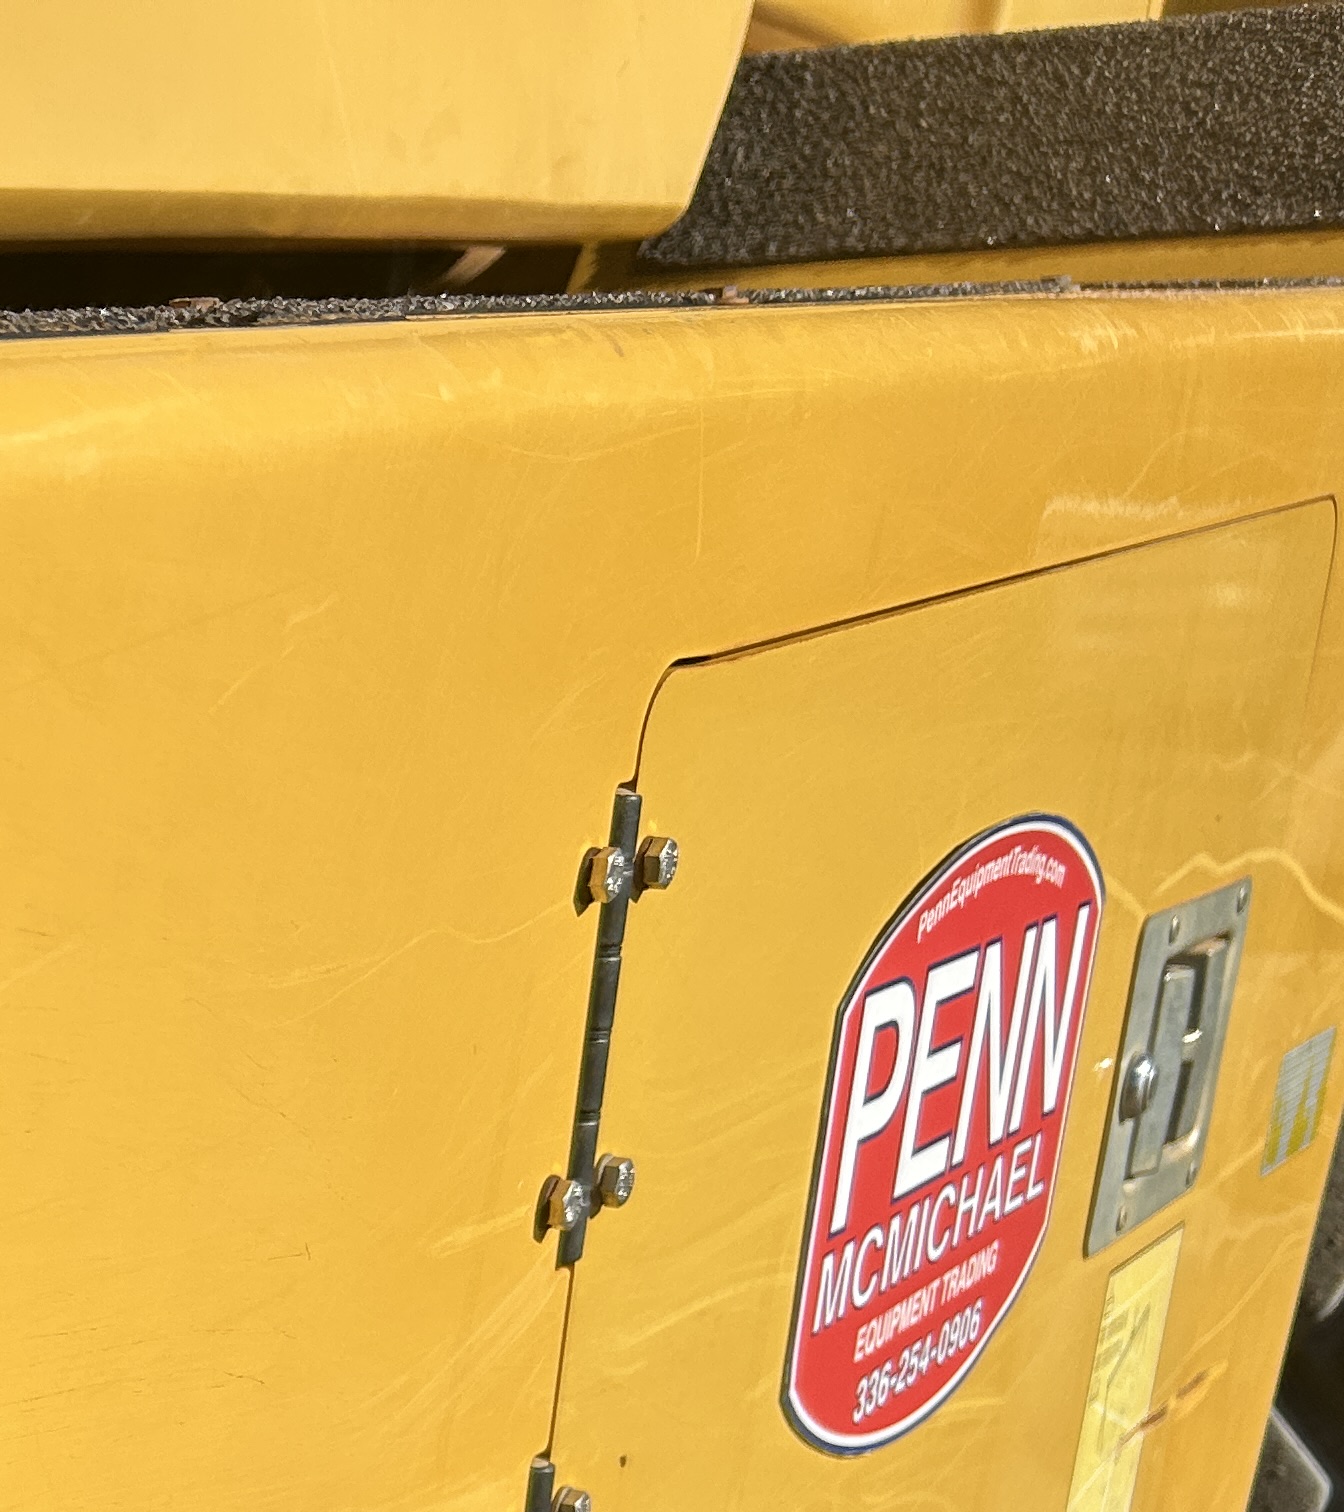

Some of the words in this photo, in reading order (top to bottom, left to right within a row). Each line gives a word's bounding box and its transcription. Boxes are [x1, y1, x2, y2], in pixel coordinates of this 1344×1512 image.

[917, 845, 1067, 943] PennEquipmentTrading.com
[828, 900, 1092, 1238] PENN
[812, 1131, 1045, 1336] MCMICHAEL
[853, 1277, 941, 1364] EQUIPMENT
[939, 1239, 1000, 1306] TRADING
[853, 1298, 984, 1425] 336-254-0906
